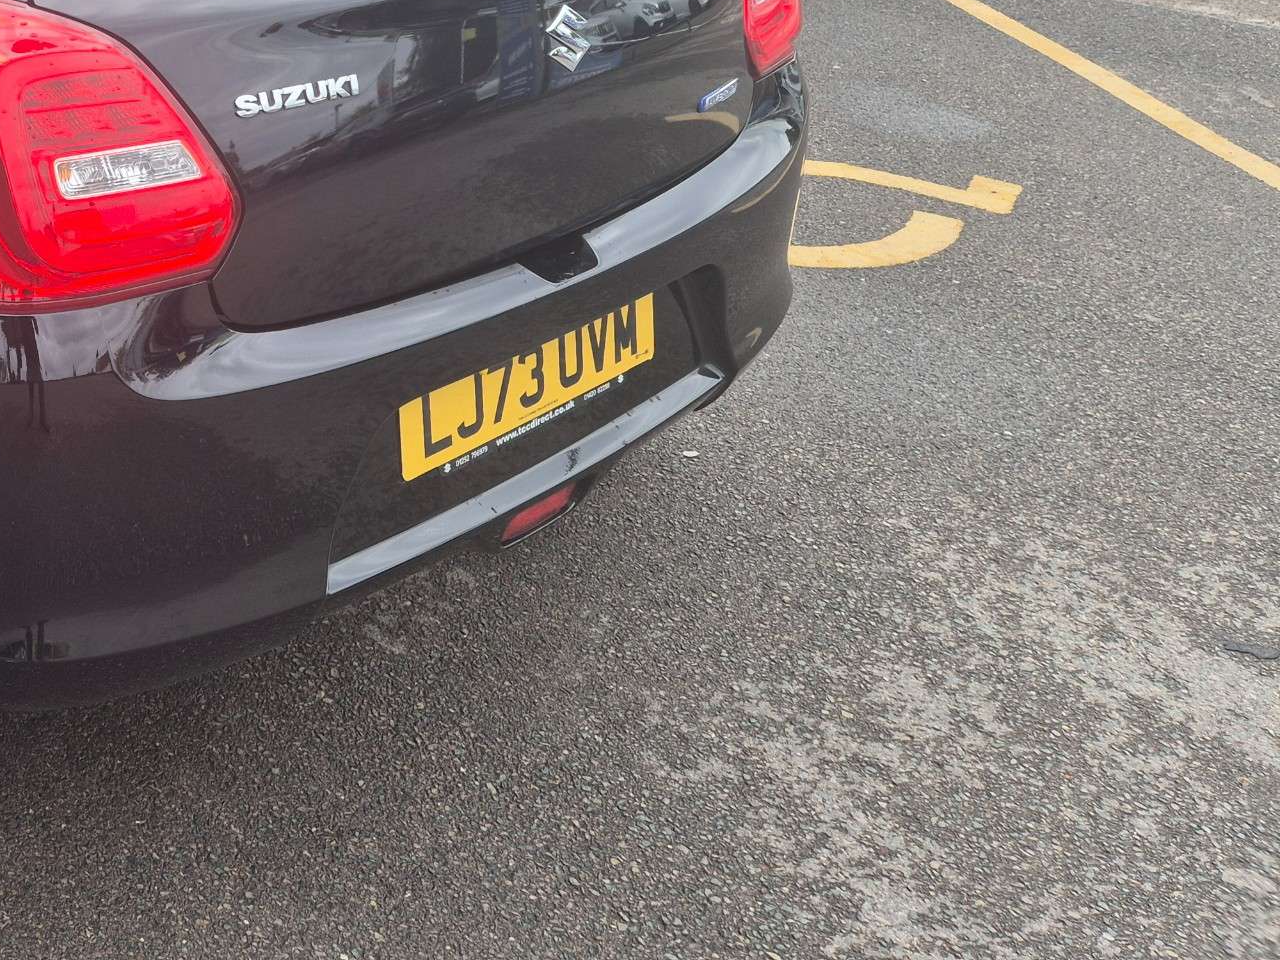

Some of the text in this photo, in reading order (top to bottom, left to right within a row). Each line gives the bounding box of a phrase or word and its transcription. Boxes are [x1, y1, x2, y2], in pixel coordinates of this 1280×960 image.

[235, 74, 359, 117] SUZUKI
[422, 303, 637, 458] LJ73 UVM
[496, 400, 575, 446] www.tccdirect.co.uk
